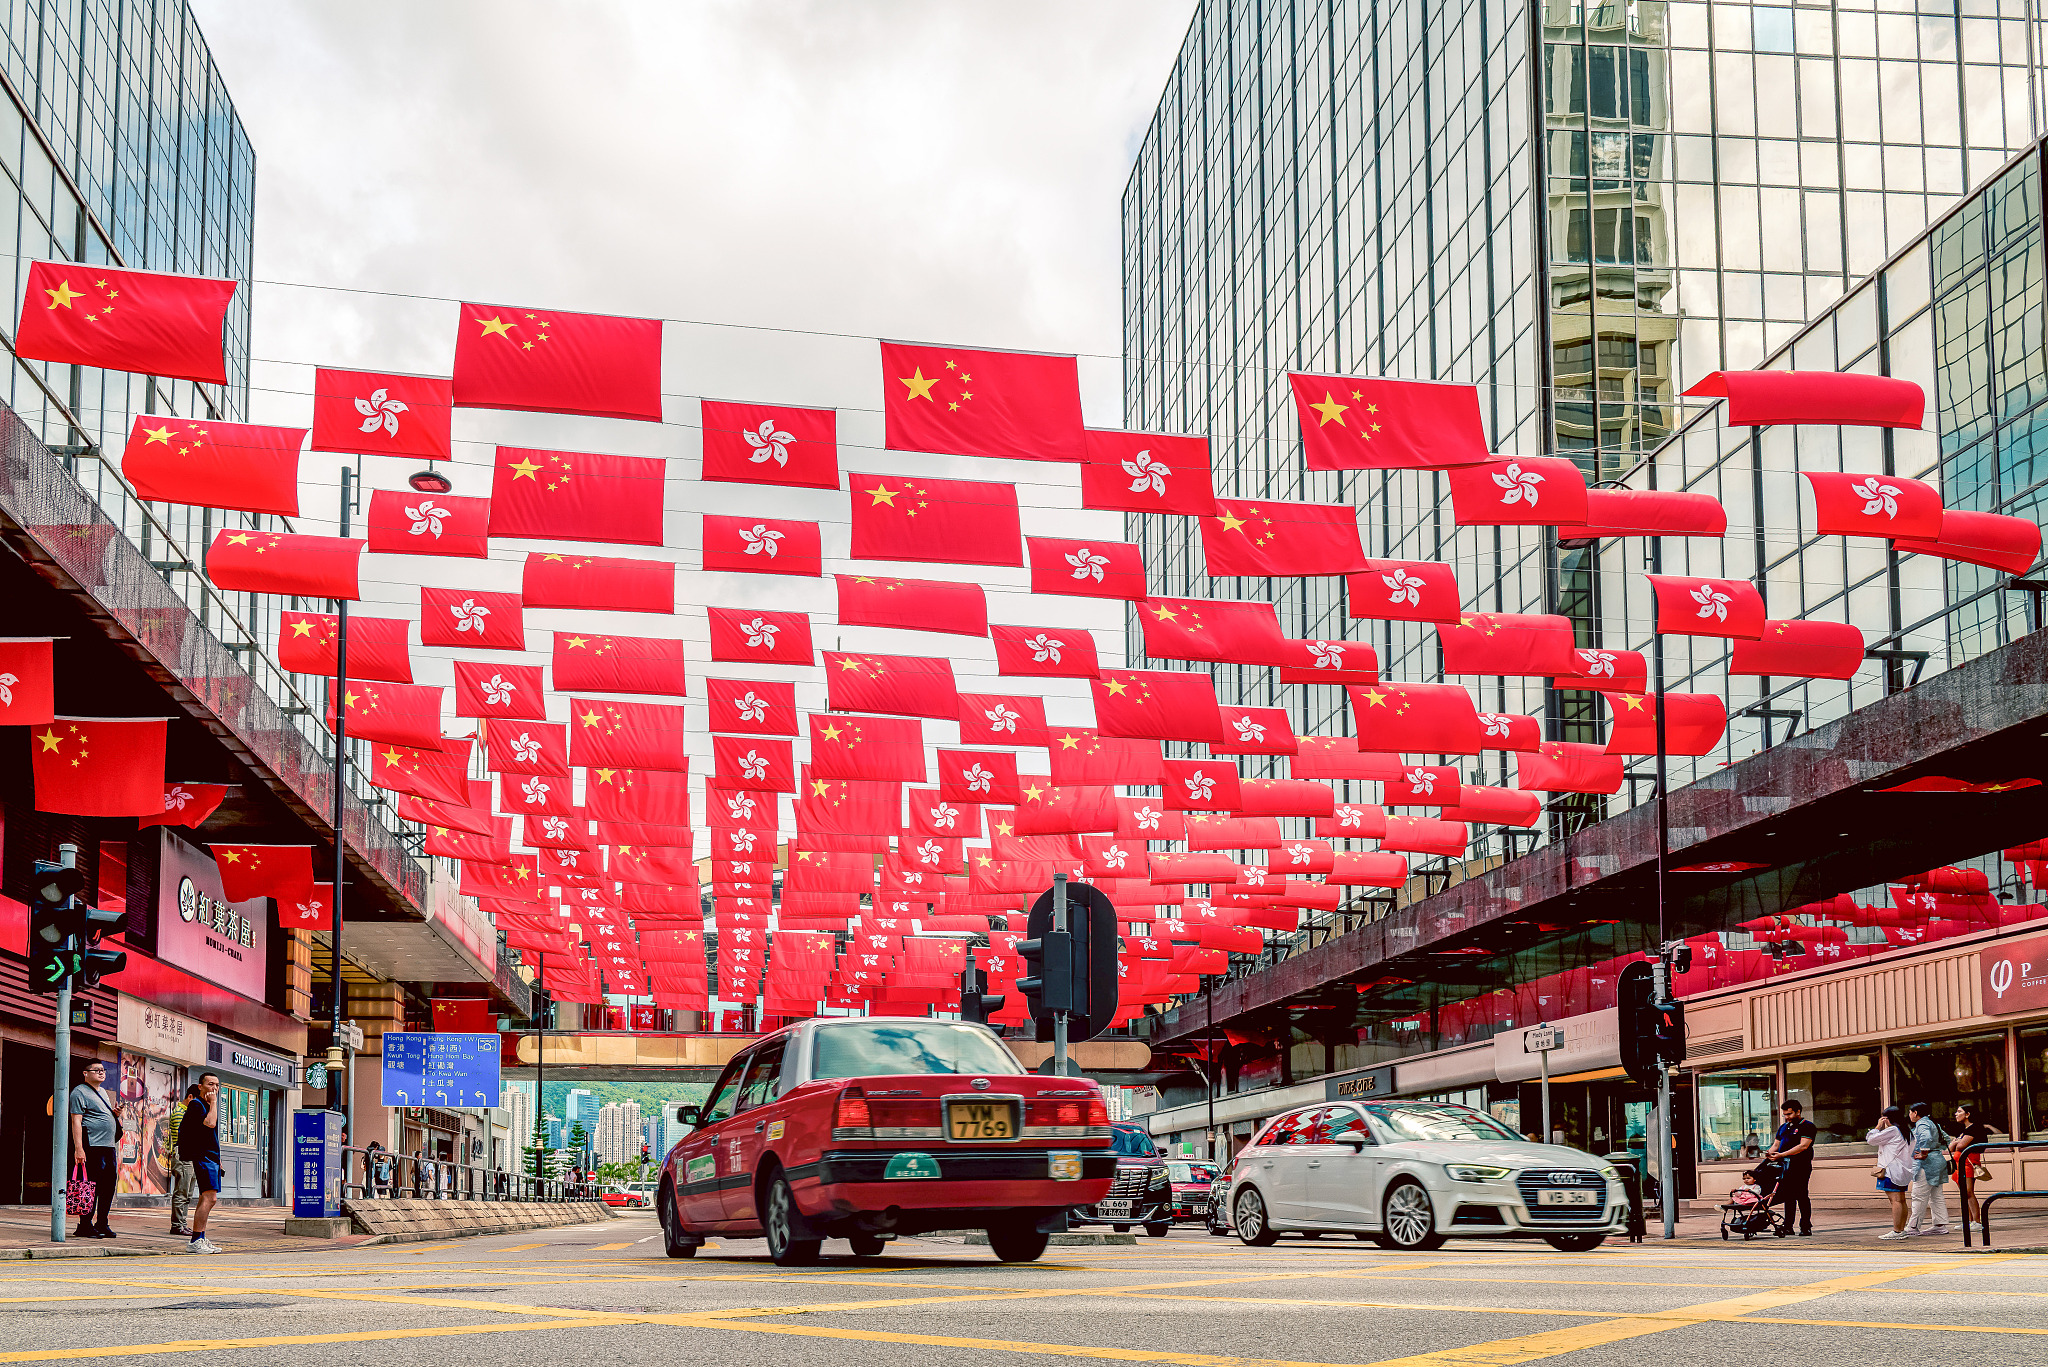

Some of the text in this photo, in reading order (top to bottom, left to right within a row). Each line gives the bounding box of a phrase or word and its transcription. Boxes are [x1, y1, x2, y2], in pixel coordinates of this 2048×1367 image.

[197, 890, 251, 948] 紅葉茶屋
[2021, 979, 2047, 988] COFFEE
[387, 1034, 422, 1043] Hong Kong
[428, 1035, 444, 1043] Hong
[446, 1035, 462, 1043] Kong
[387, 1043, 405, 1052] 香港
[406, 1052, 421, 1060] Tong
[427, 1053, 444, 1061] Hung
[462, 1053, 475, 1061] Bay
[234, 1051, 284, 1077] STARBUCKS COFFEE
[954, 1120, 1008, 1137] 7769
[906, 1158, 918, 1169] 4
[1100, 1200, 1128, 1208] KL 669
